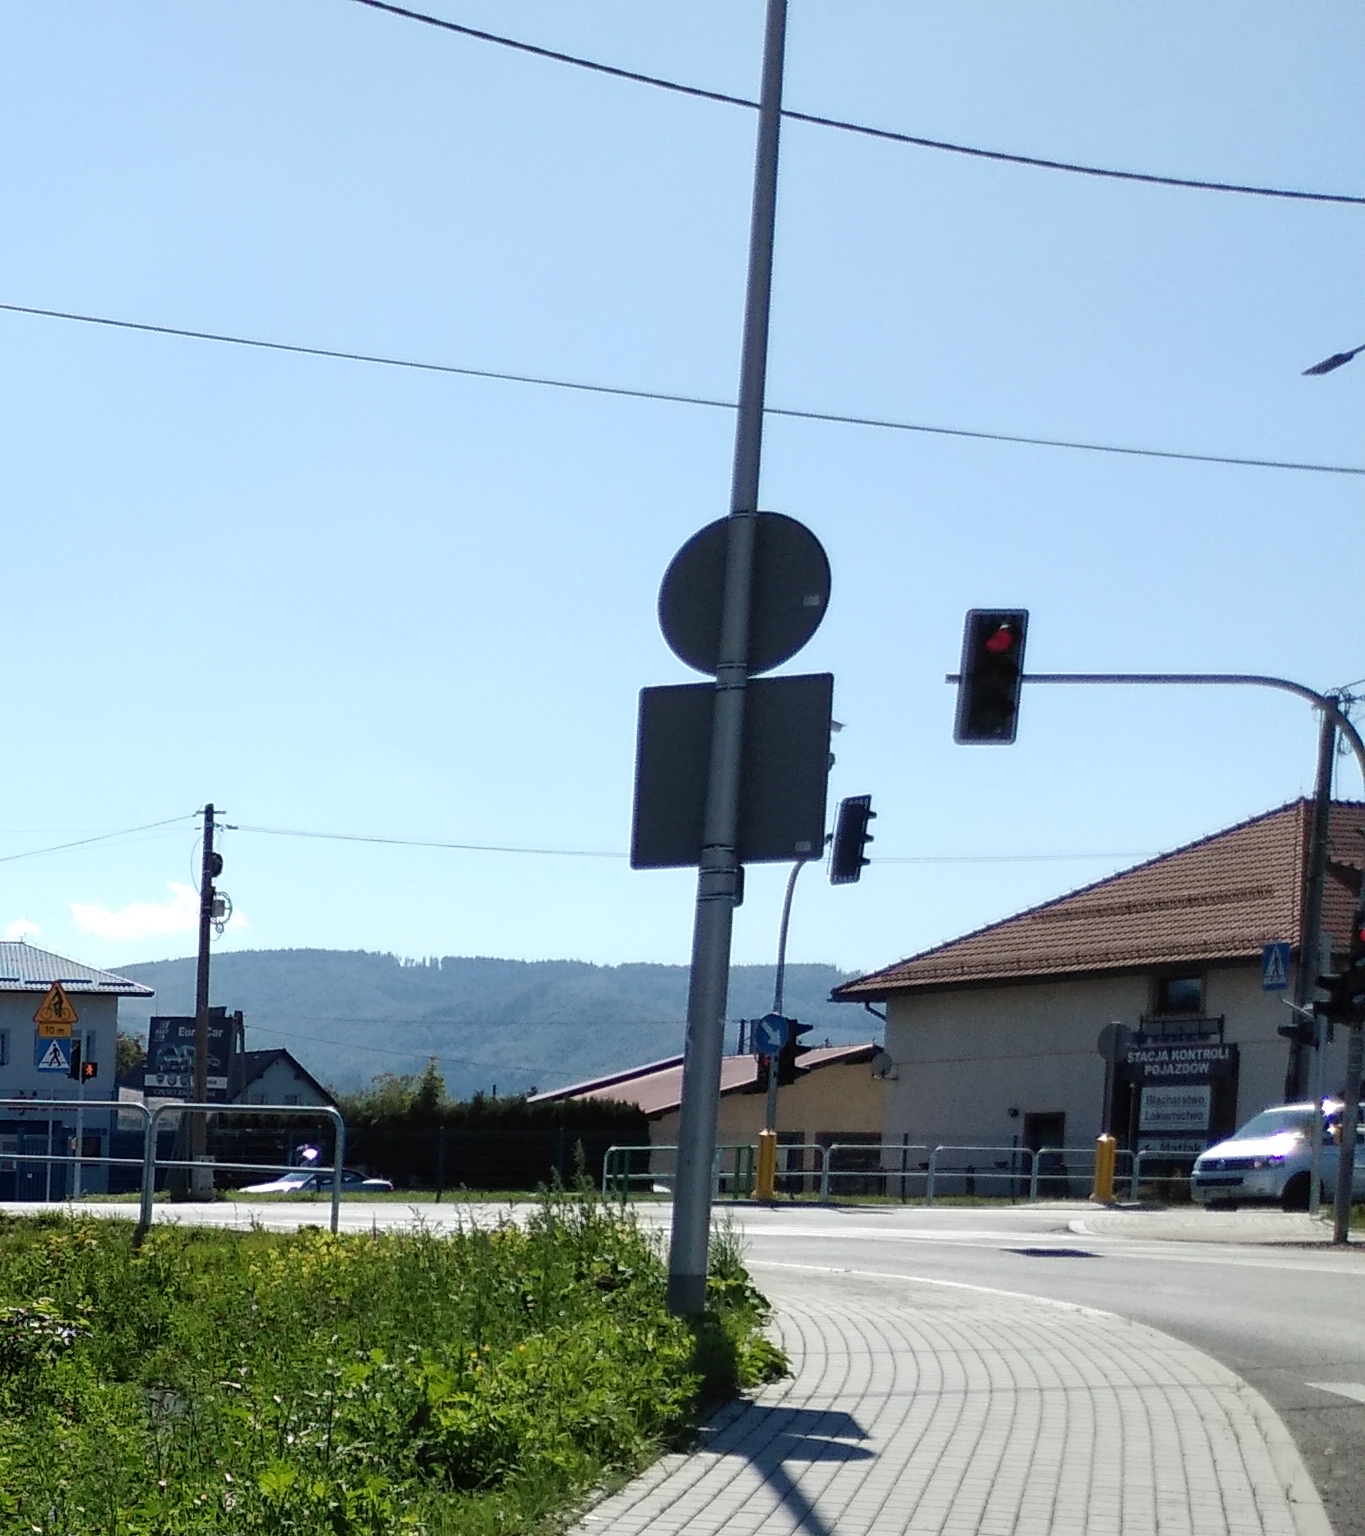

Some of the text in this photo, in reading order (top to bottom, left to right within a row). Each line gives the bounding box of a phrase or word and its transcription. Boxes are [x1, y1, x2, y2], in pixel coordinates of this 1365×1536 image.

[45, 1026, 55, 1035] 10
[178, 1027, 196, 1037] Eur
[1127, 1048, 1230, 1063] STACJA KONTROLI
